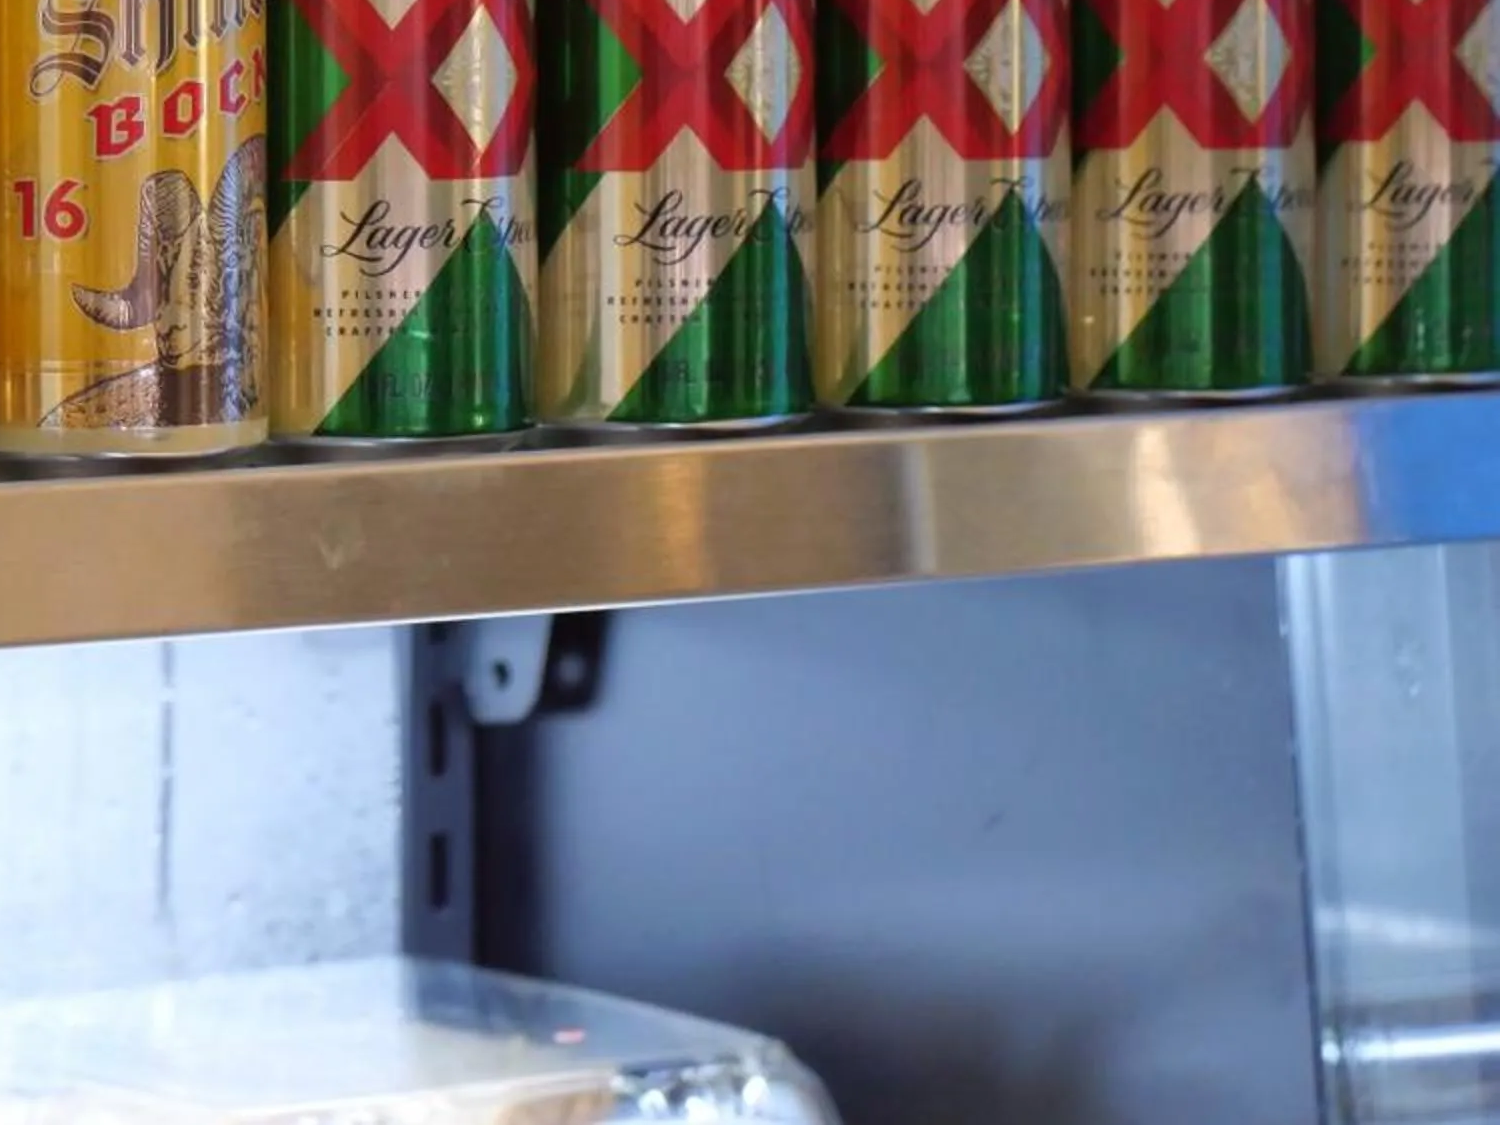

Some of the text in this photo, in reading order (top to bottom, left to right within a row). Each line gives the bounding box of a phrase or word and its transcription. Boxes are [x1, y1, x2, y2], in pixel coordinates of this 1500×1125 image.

[13, 180, 86, 239] 16
[320, 200, 463, 277] Lager
[613, 189, 748, 266] Lager
[856, 179, 990, 253] Lager
[1096, 167, 1224, 241] Lager
